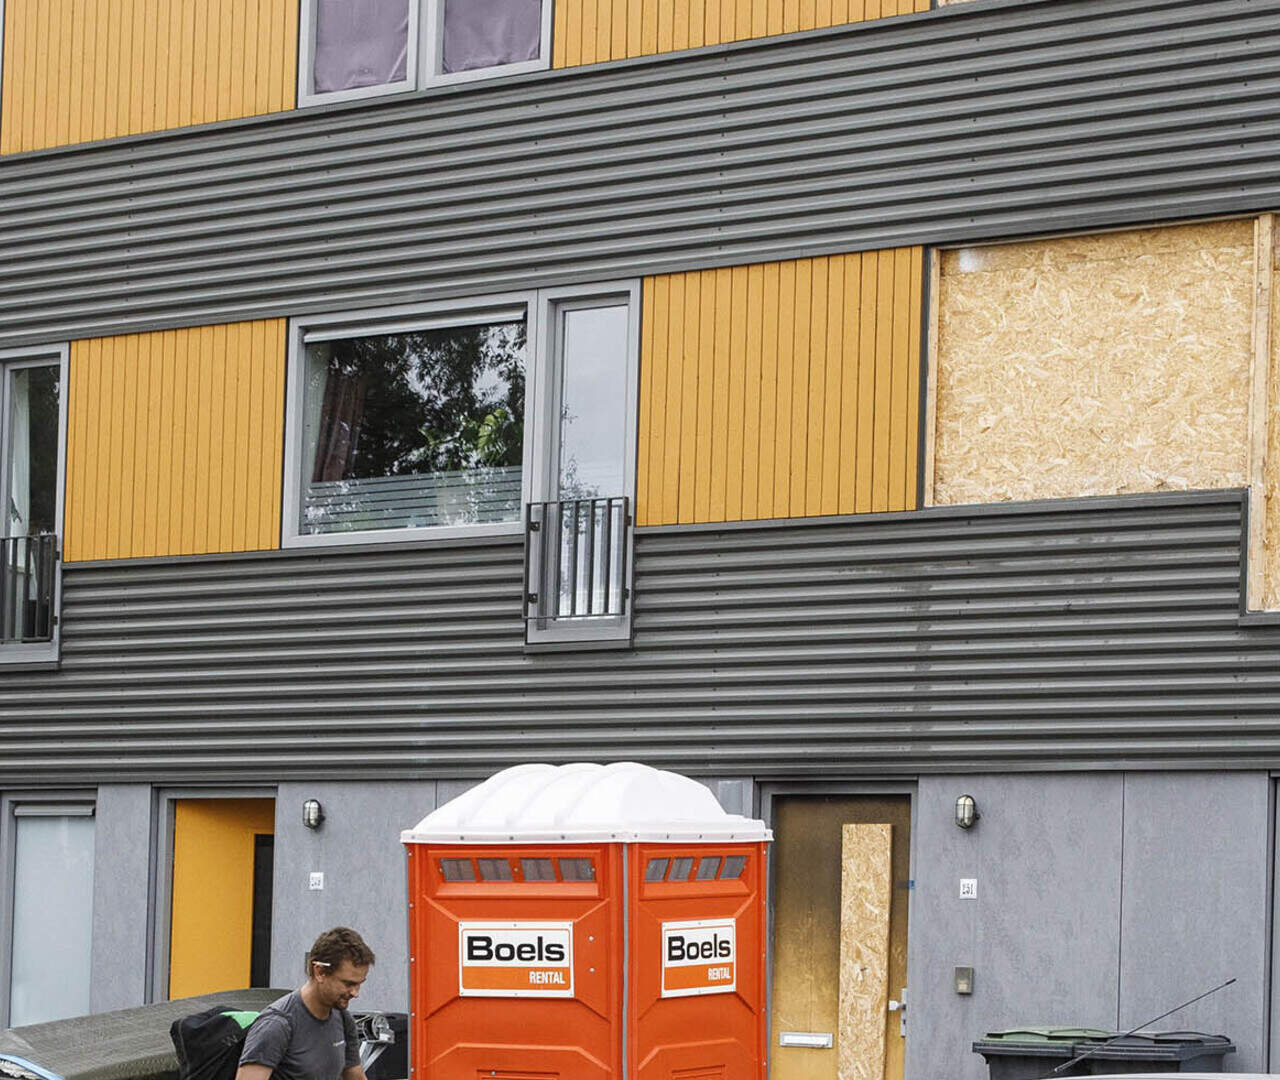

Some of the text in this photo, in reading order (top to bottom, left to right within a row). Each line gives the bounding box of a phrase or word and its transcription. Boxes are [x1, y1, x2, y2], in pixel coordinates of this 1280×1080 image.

[467, 936, 565, 961] Boels
[668, 933, 731, 961] Boels
[529, 971, 565, 984] RENTAL
